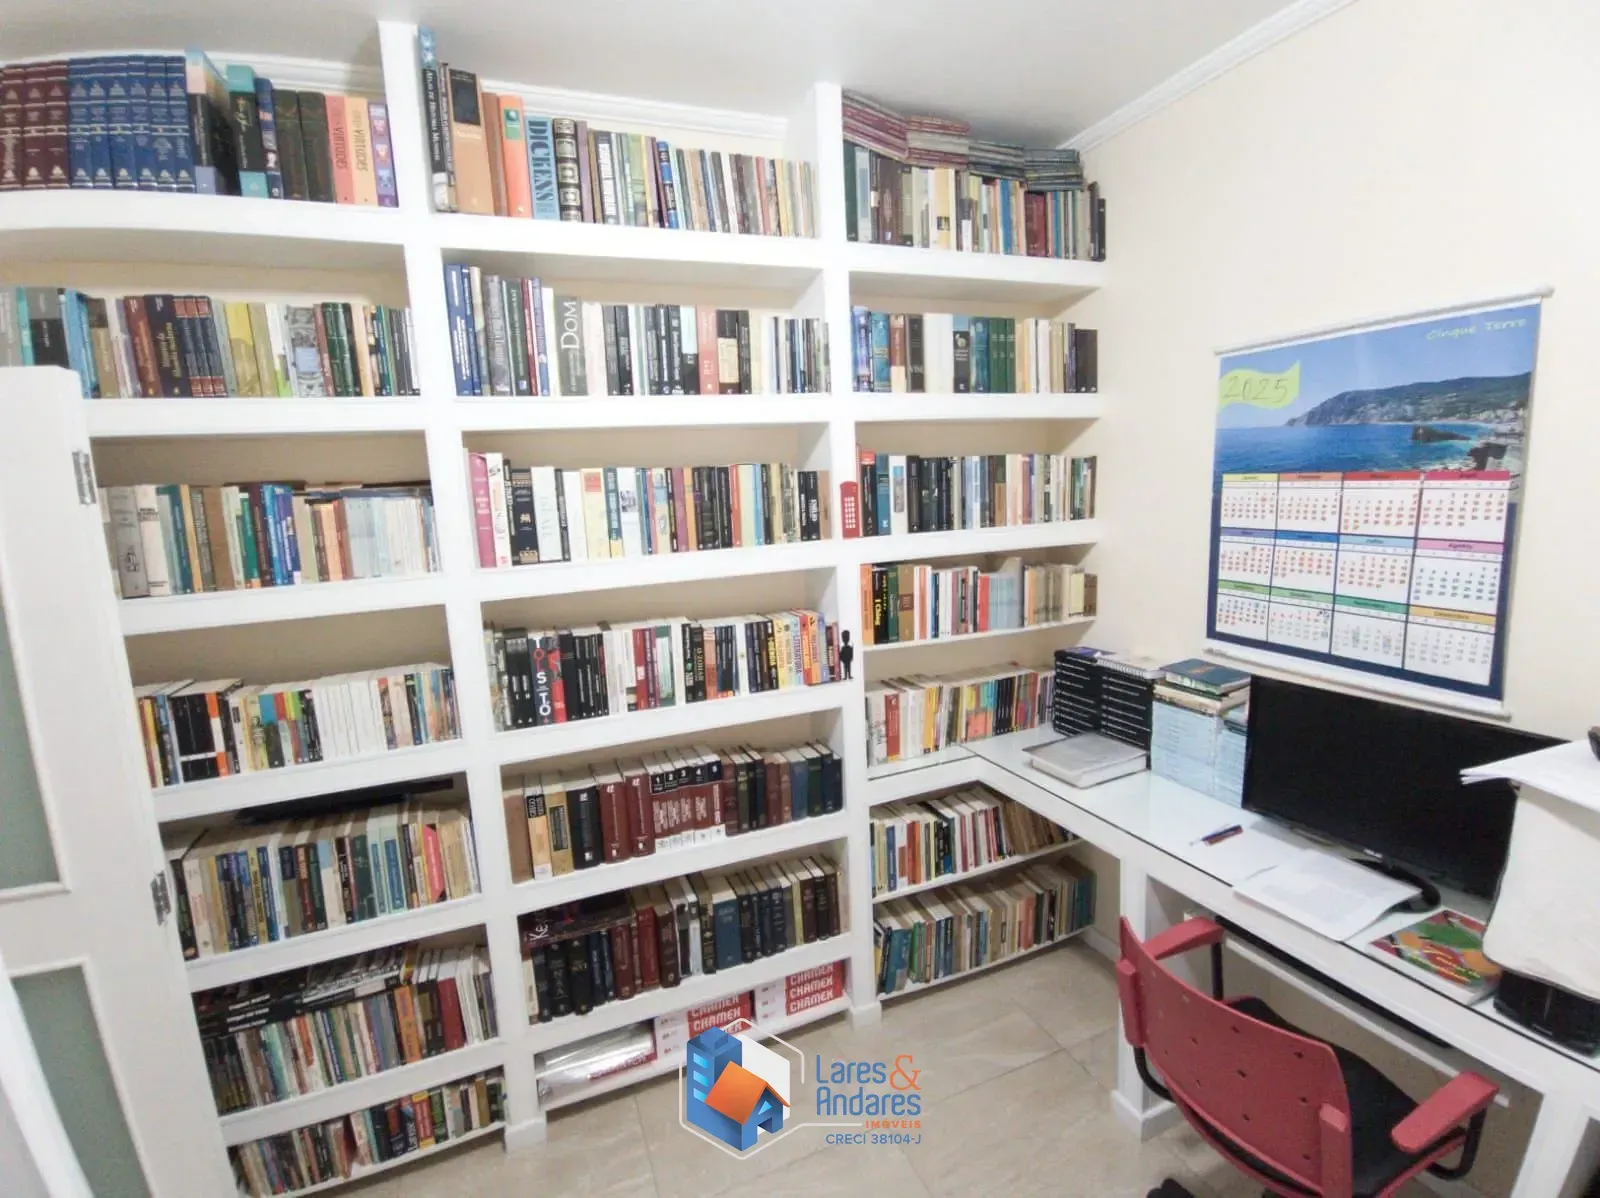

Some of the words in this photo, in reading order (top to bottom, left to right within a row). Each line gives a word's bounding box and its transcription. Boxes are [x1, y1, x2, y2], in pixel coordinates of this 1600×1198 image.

[527, 120, 555, 201] DICKENS
[560, 301, 580, 349] DOM
[1222, 375, 1289, 403] 2025
[789, 974, 833, 998] CHAMEX
[789, 988, 833, 1013] CHAMEX
[693, 1007, 741, 1032] CHAMEX
